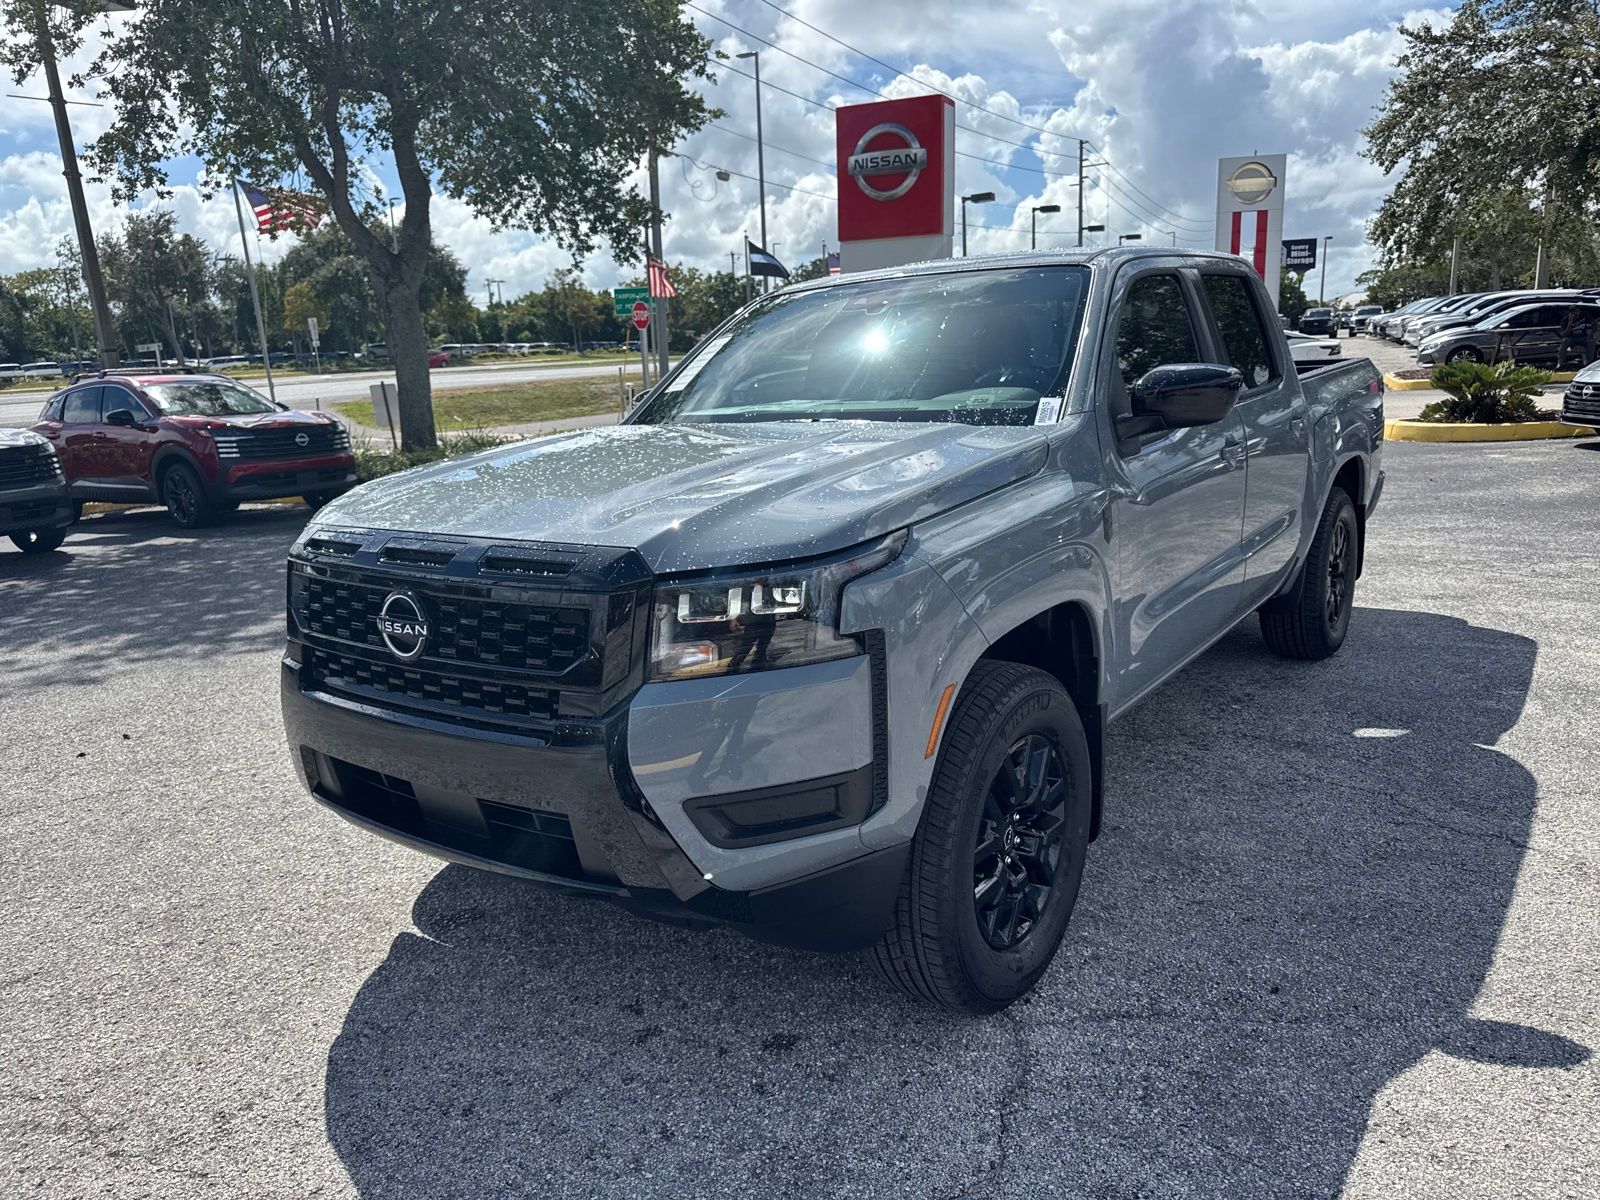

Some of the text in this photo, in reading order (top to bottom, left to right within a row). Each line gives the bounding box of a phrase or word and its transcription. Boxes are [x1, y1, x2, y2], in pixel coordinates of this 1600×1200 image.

[853, 153, 918, 171] NISSAN
[1290, 250, 1312, 258] Mini-
[1286, 257, 1315, 265] Storage
[632, 311, 649, 321] STOP
[376, 617, 428, 636] NISSAN
